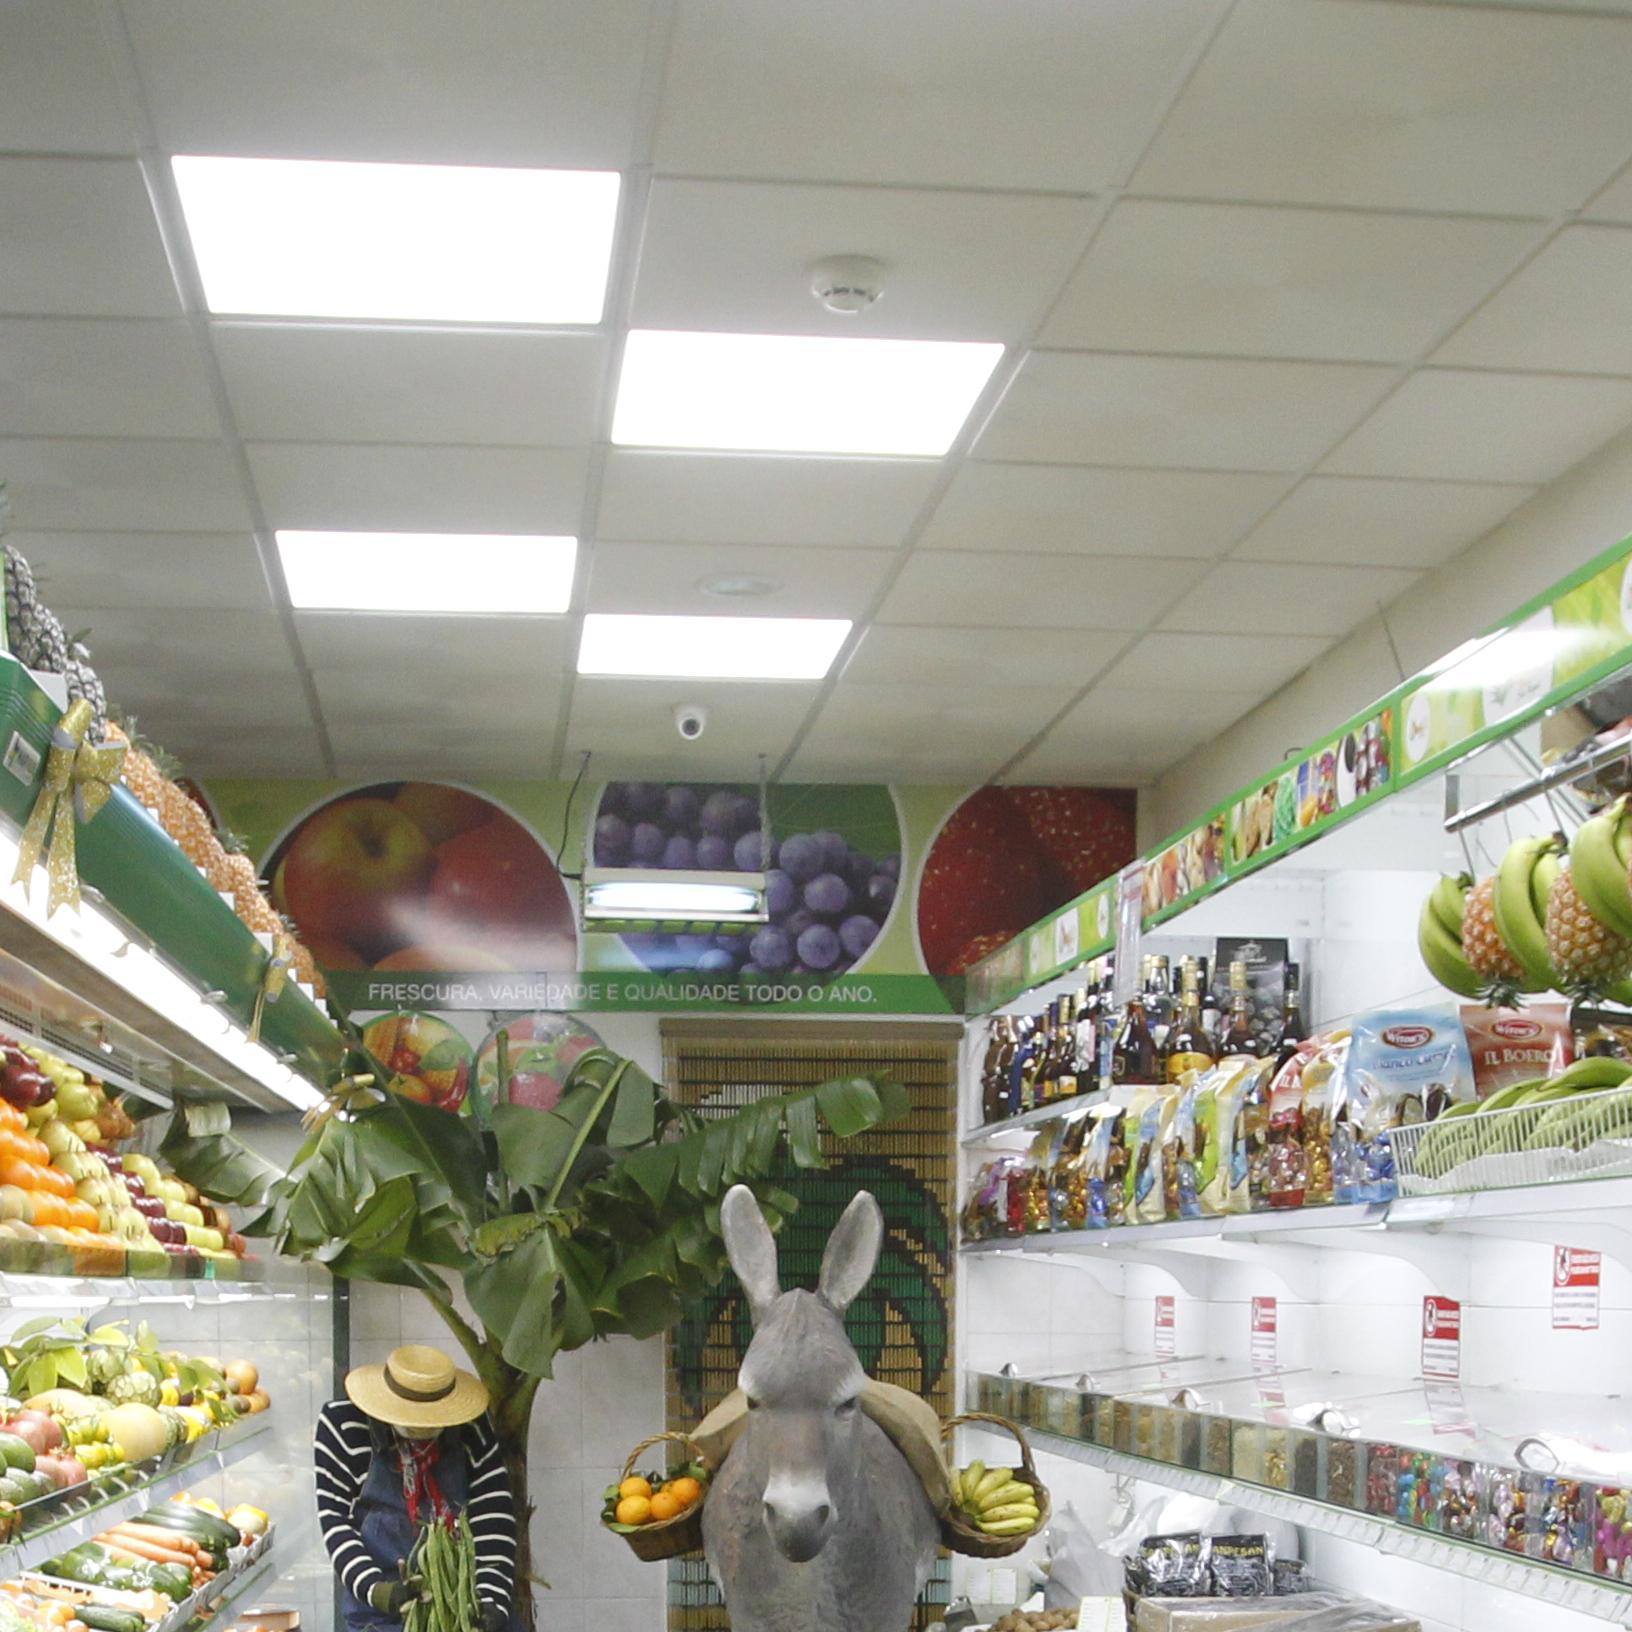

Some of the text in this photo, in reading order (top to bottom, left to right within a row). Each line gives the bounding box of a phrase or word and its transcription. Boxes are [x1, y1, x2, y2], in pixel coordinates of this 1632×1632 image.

[368, 983, 877, 1003] FRESCURA, VARIEDADE E QUALIDADE TODO O ANO.
